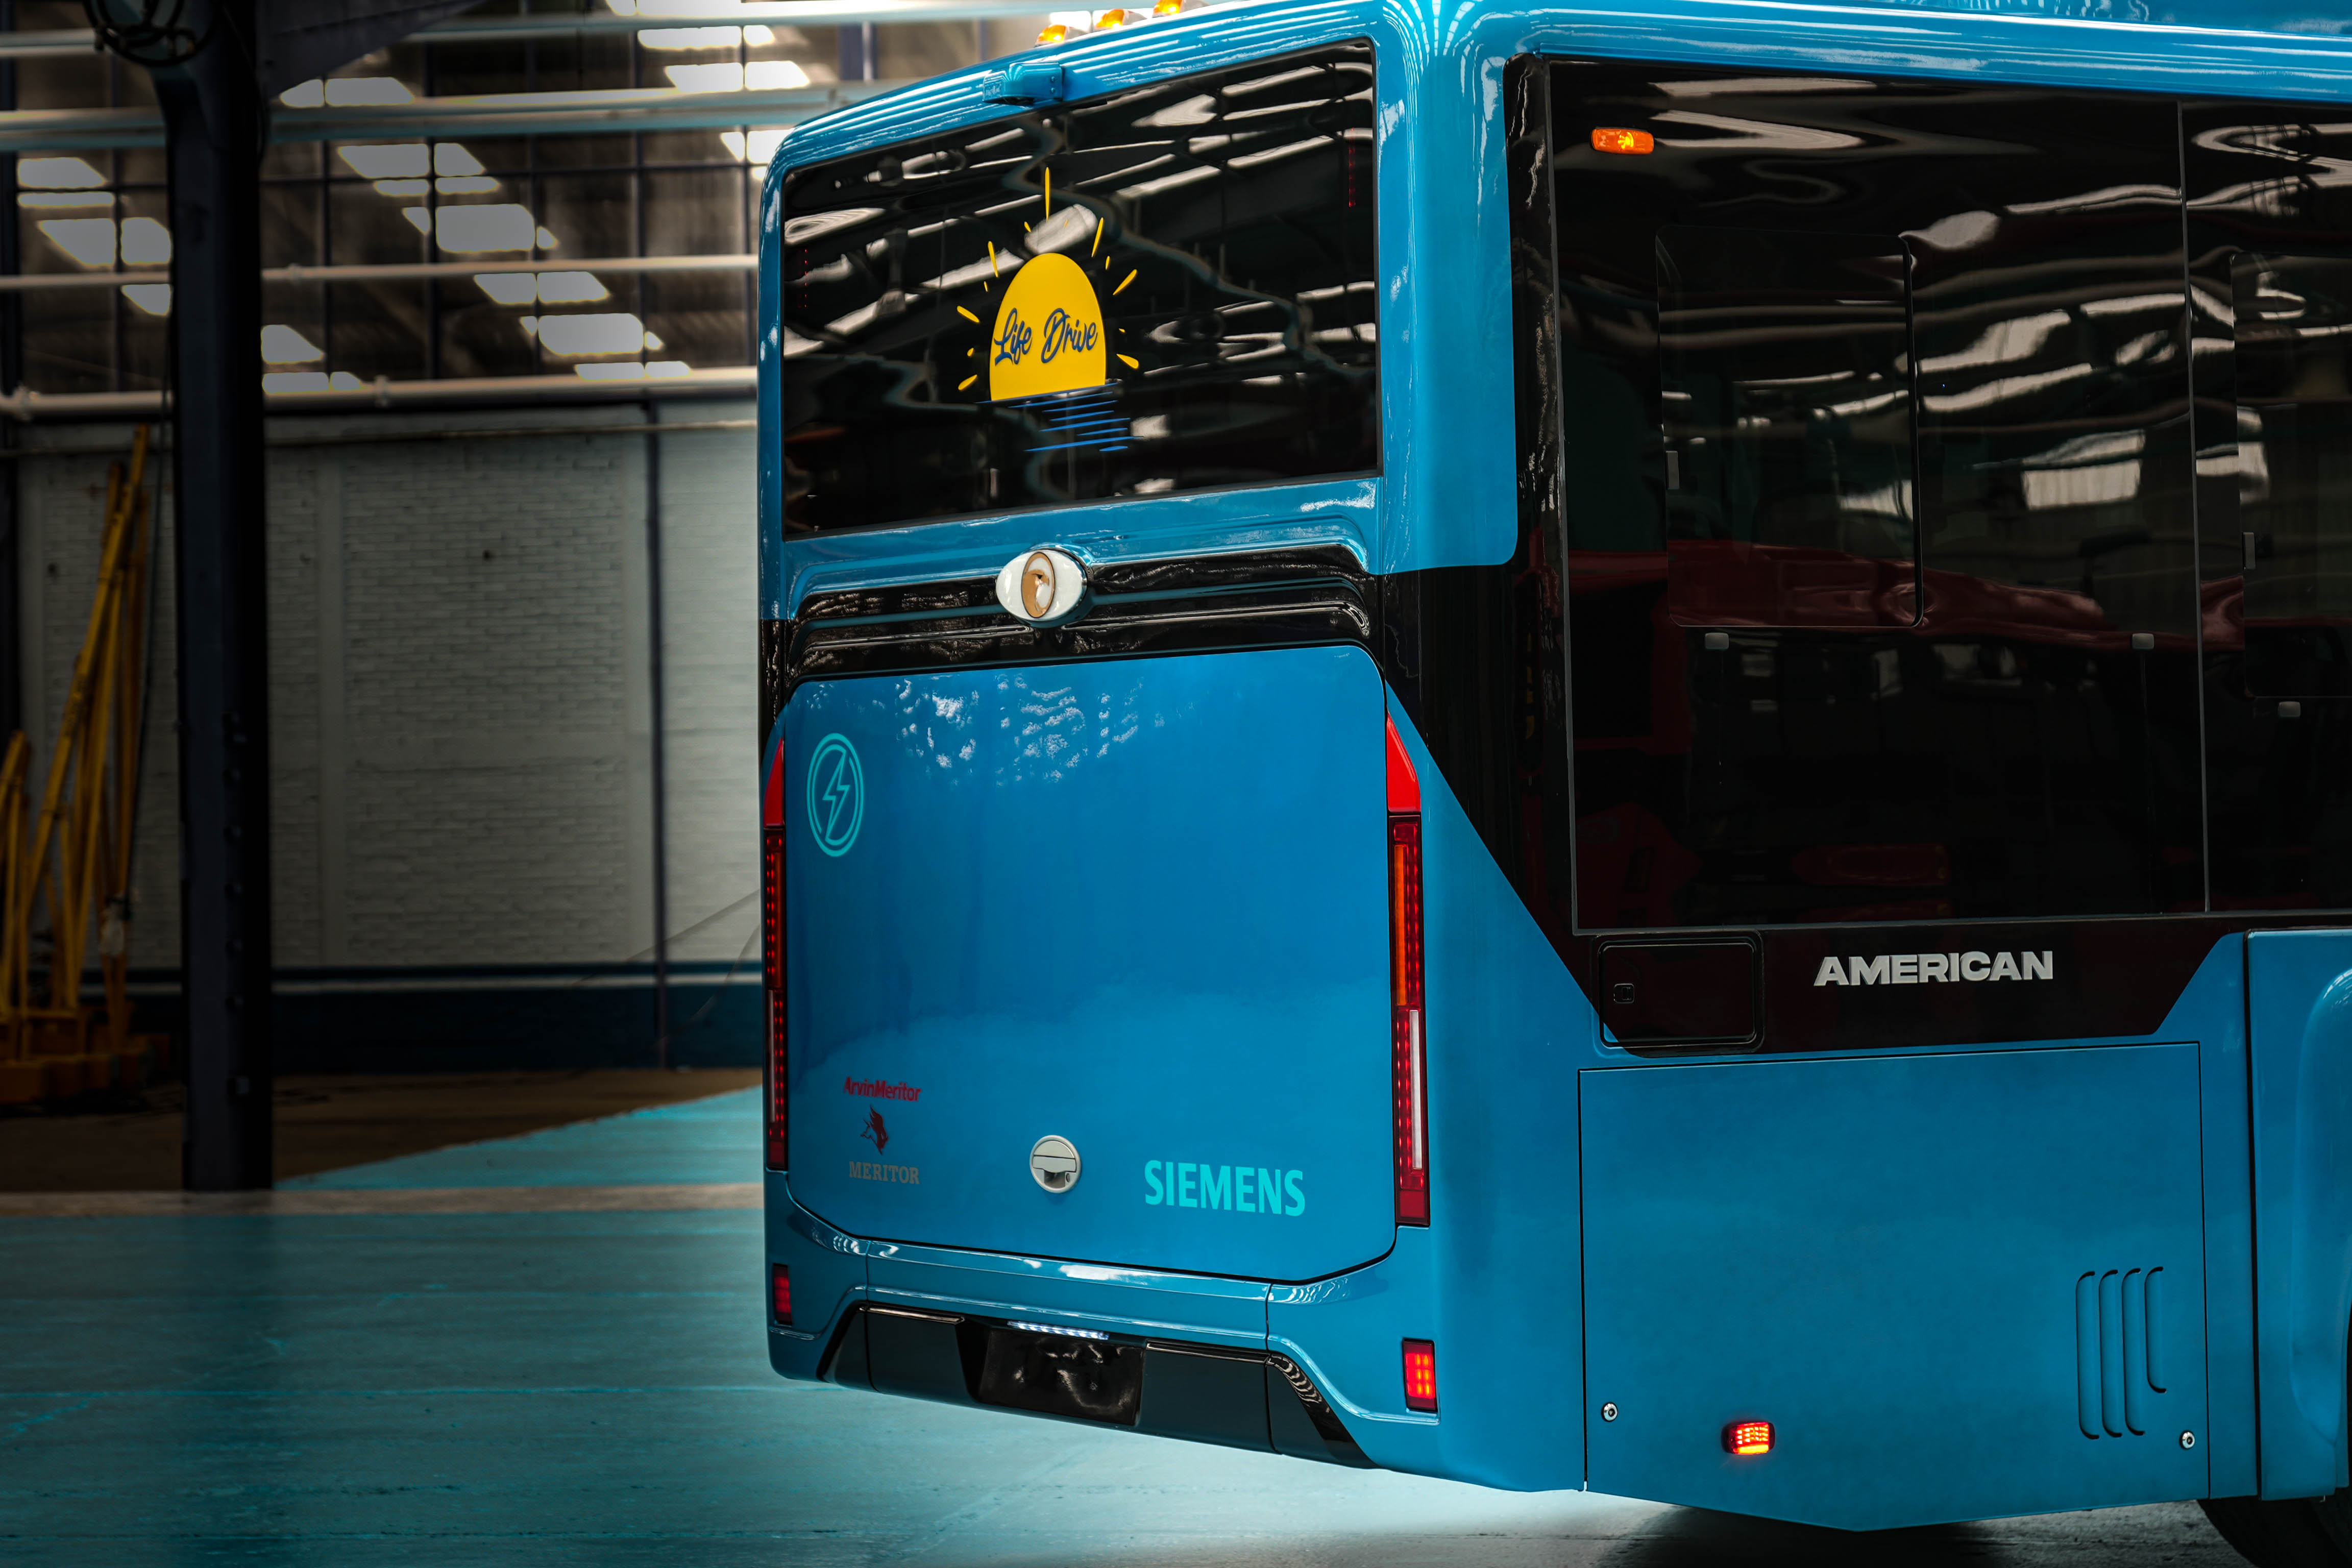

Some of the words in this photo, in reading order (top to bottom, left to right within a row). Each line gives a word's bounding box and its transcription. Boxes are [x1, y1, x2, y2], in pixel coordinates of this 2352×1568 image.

[994, 307, 1033, 365] Life
[1040, 307, 1098, 363] Drive
[1813, 950, 2054, 987] AMERICAN
[843, 1076, 922, 1102] ArvinMeritor
[848, 1161, 921, 1185] MERITOR
[1144, 1159, 1306, 1217] SIEMENS
